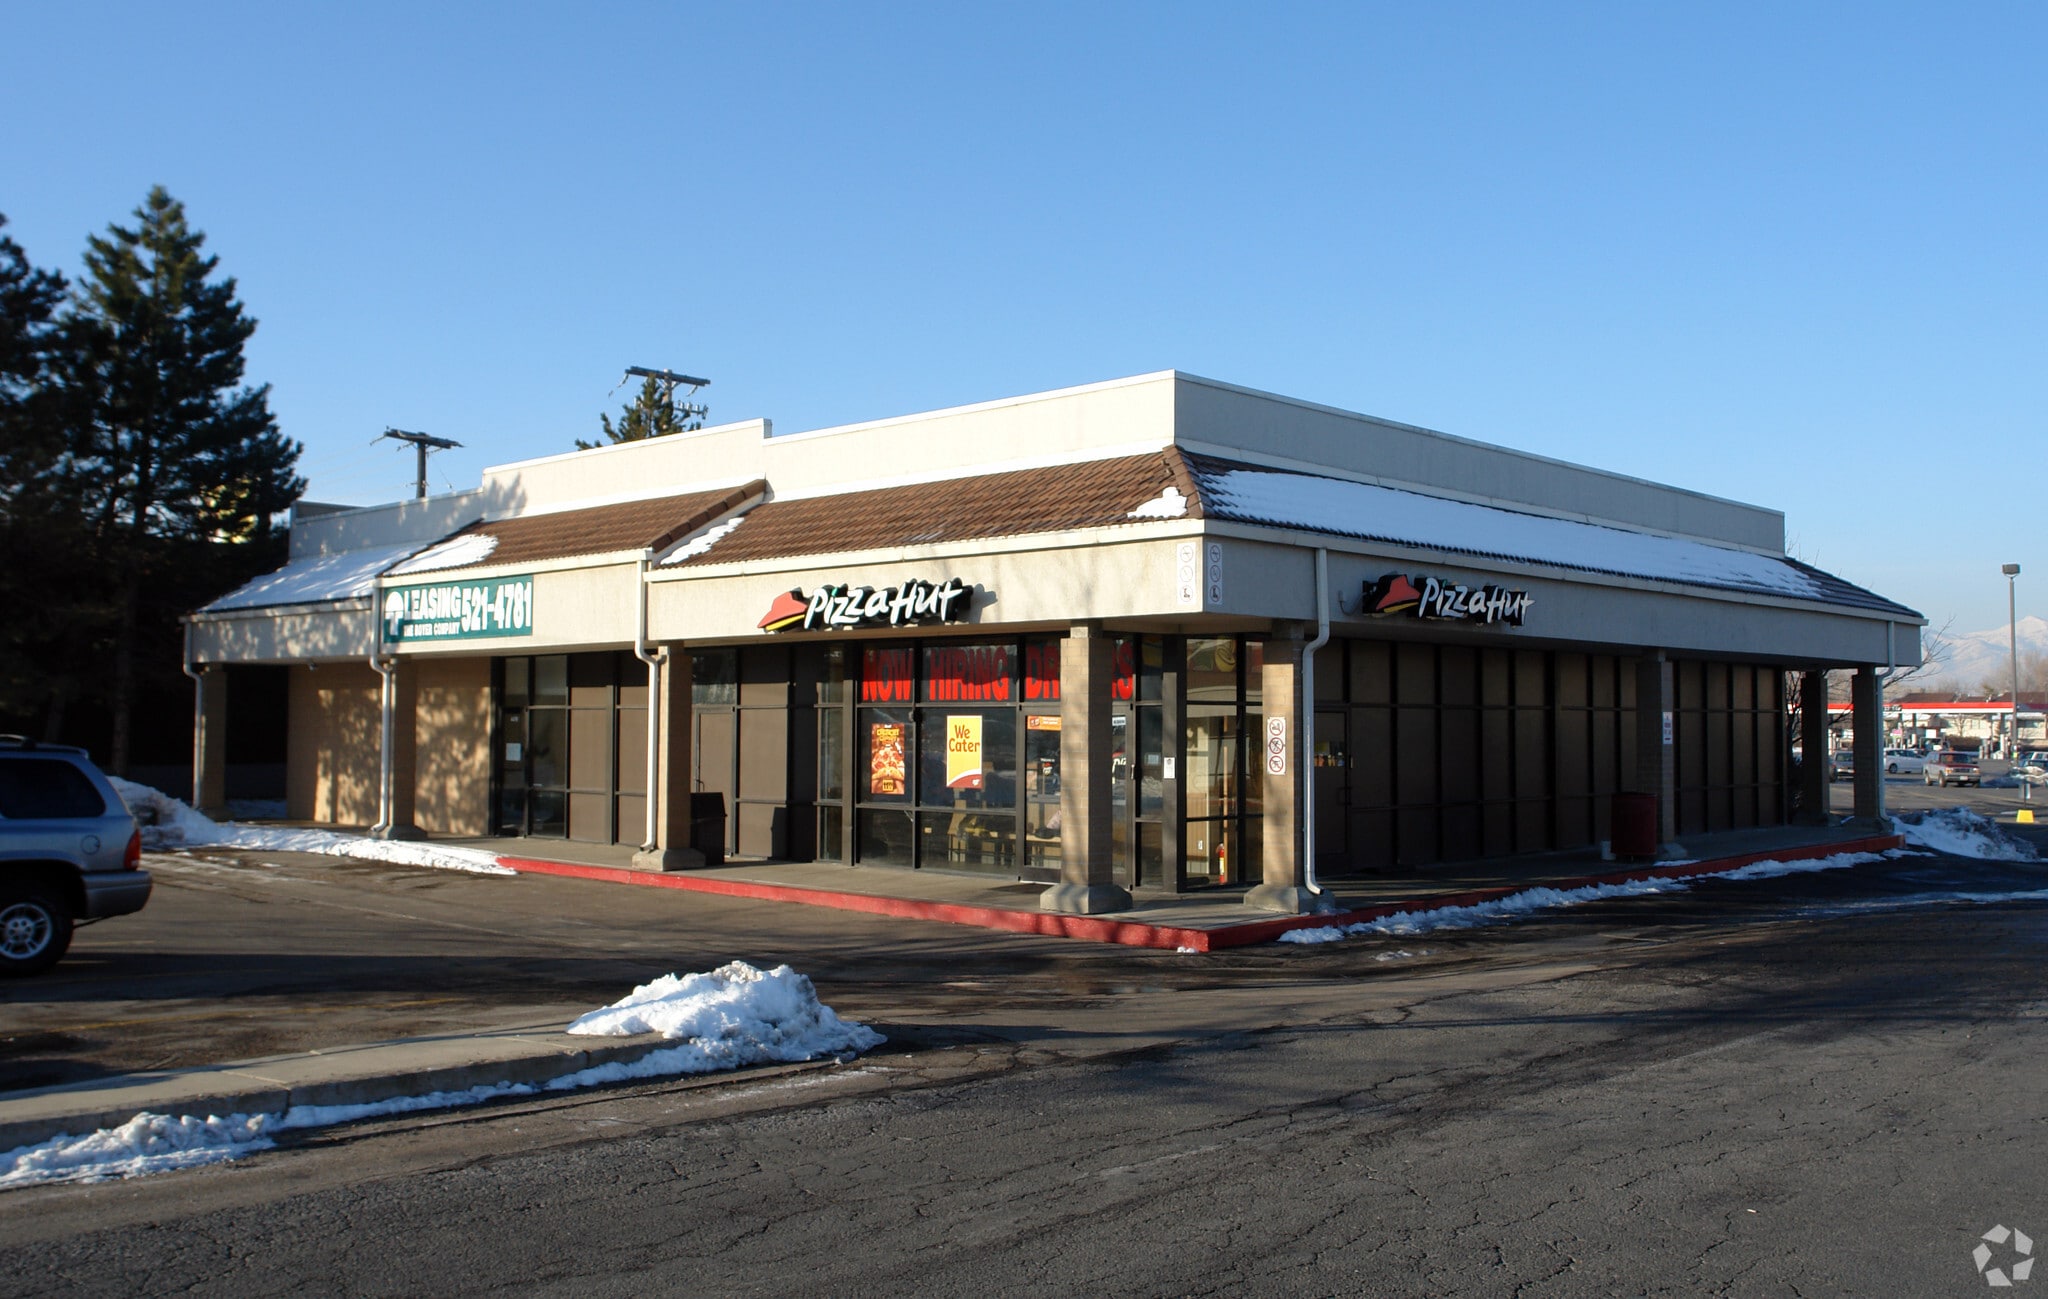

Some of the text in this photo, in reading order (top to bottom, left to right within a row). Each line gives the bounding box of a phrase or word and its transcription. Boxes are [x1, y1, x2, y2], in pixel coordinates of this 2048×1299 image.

[404, 582, 532, 632] LEASING 521-4781
[433, 622, 460, 636] COMPANY
[862, 648, 913, 702] NOW
[929, 646, 1009, 701] HIRING
[954, 724, 971, 739] We
[949, 738, 981, 753] Cater
